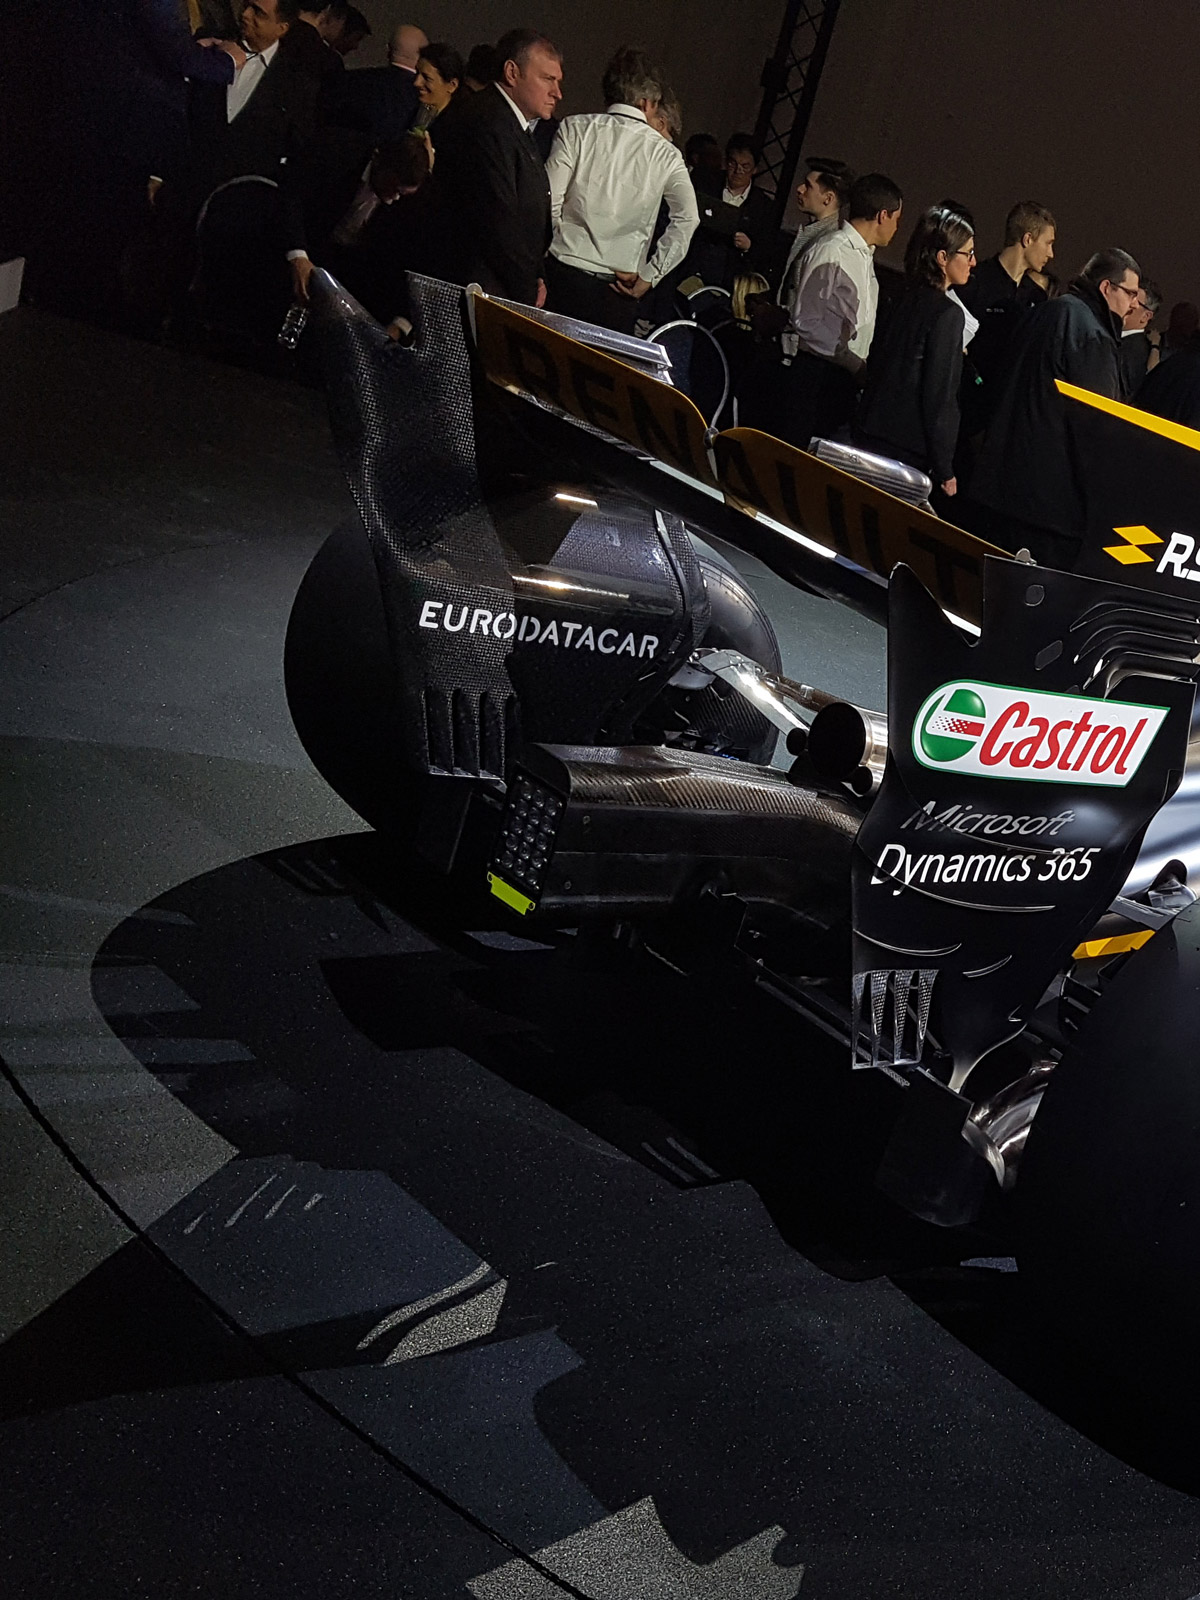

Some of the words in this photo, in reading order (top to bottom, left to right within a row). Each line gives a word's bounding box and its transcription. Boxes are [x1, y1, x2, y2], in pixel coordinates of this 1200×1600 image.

[419, 601, 659, 658] EURODATACAR
[979, 701, 1148, 775] Castrol
[901, 801, 1075, 835] Microsoft
[870, 844, 1036, 895] Dynamics
[1038, 847, 1100, 881] 365
